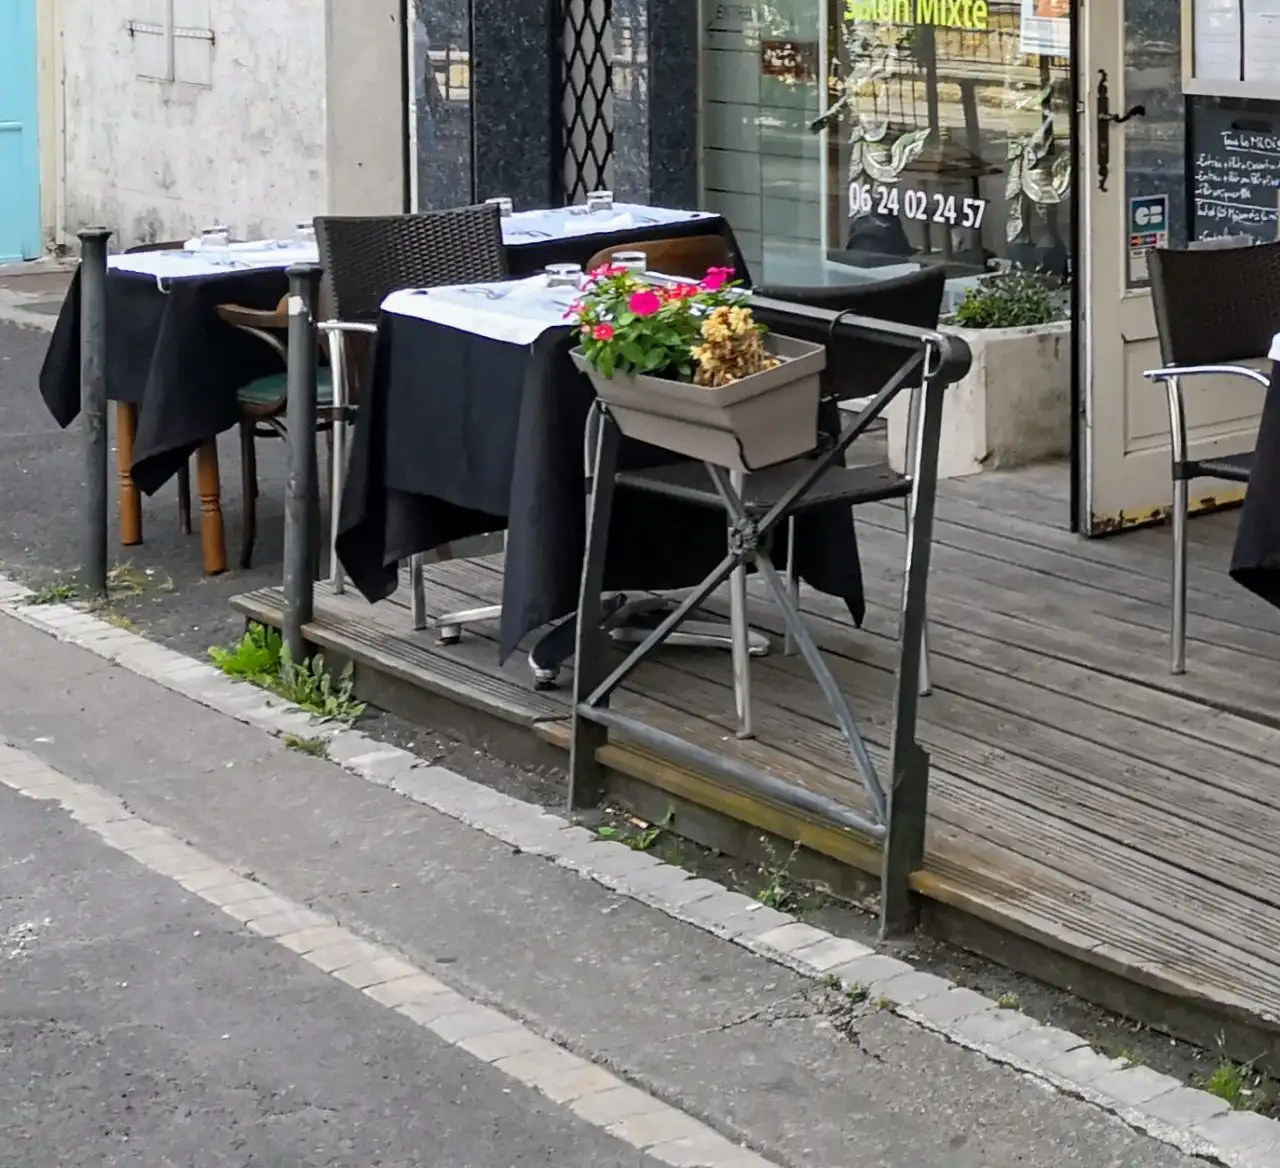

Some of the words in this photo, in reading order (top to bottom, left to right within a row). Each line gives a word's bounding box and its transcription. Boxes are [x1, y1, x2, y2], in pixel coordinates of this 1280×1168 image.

[849, 182, 873, 212] 06
[877, 186, 900, 216] 24
[904, 189, 928, 220] 02
[932, 193, 957, 225] 24
[962, 197, 986, 228] 57
